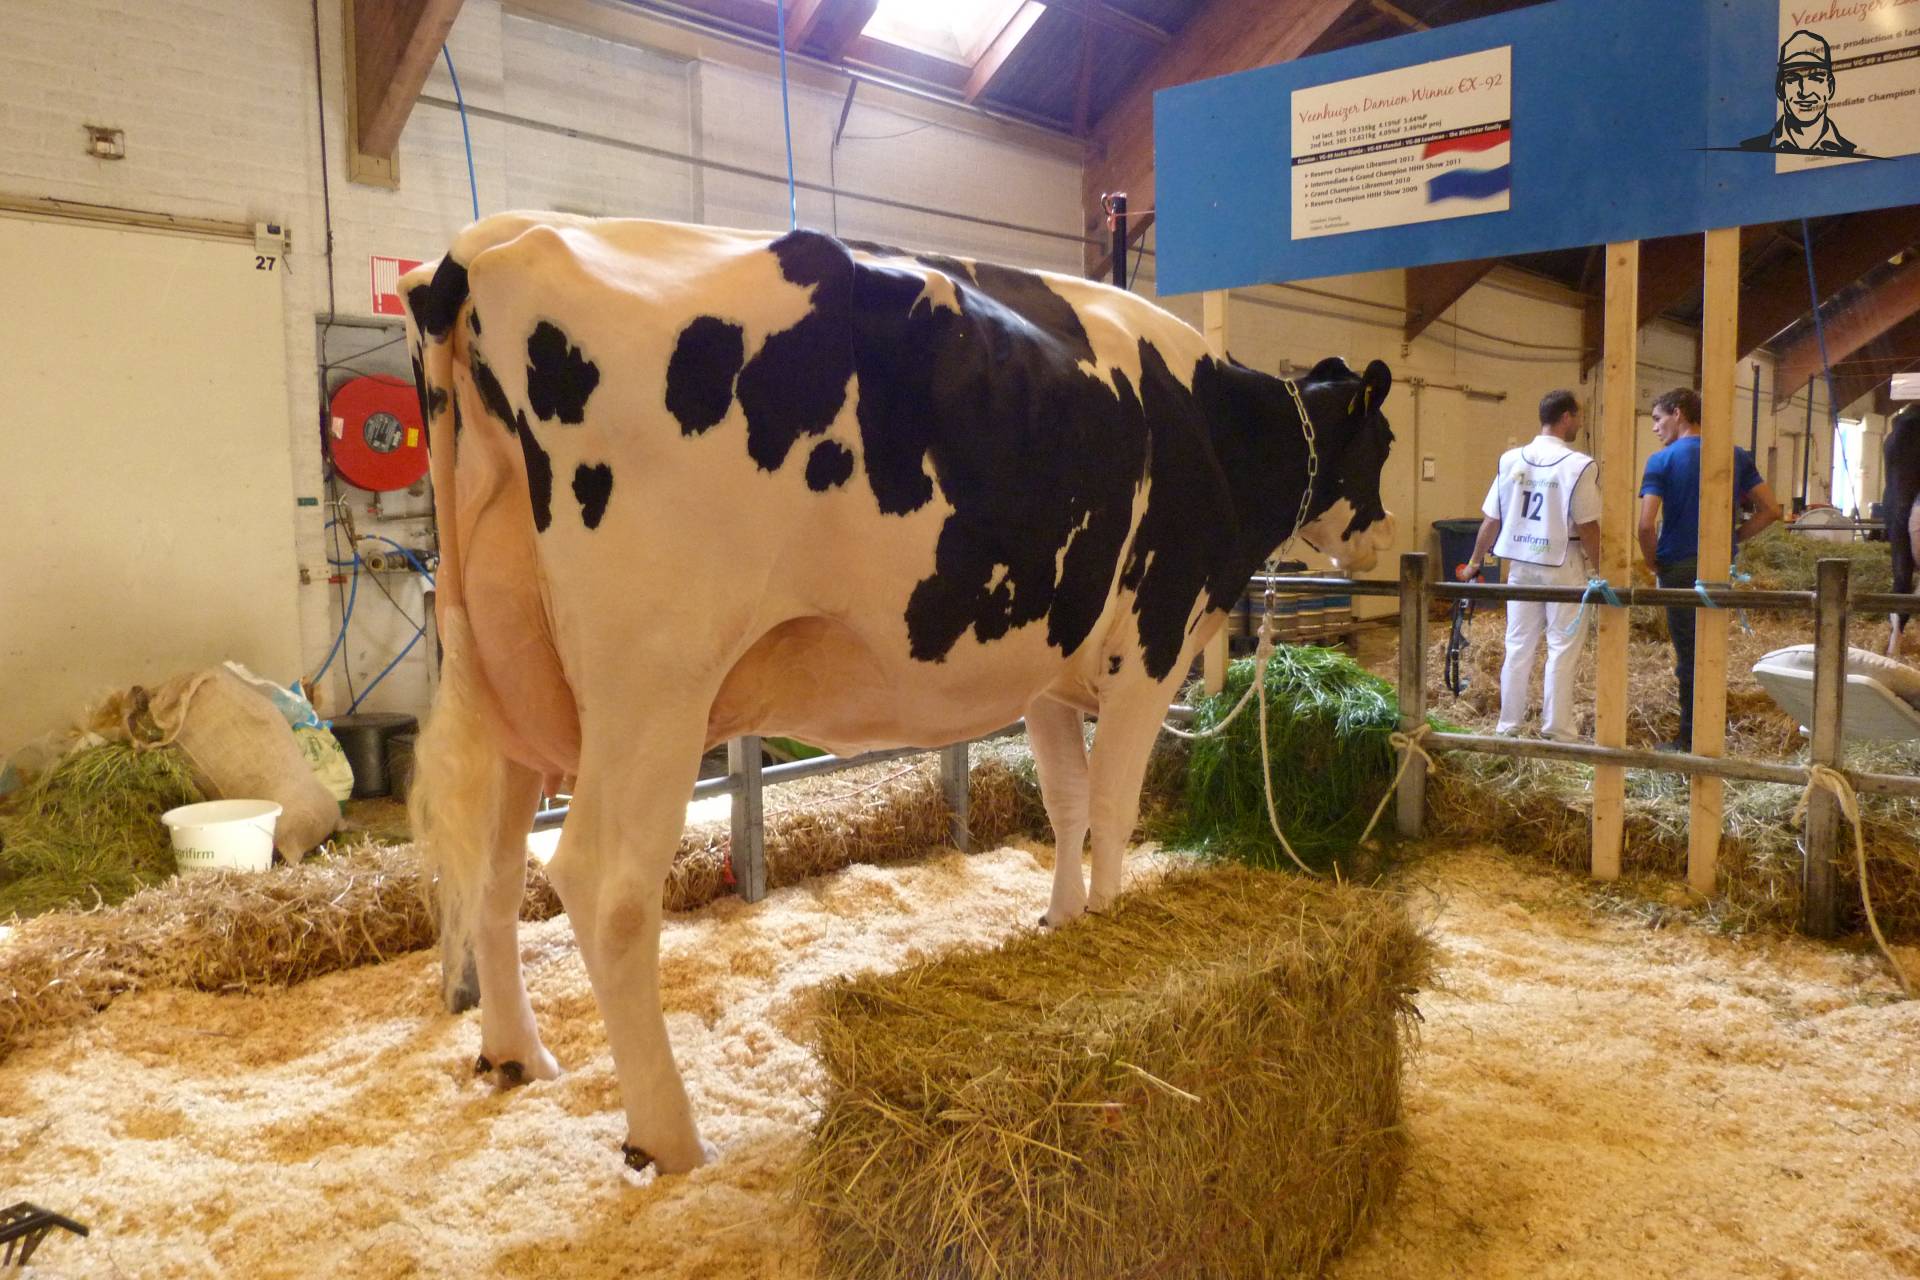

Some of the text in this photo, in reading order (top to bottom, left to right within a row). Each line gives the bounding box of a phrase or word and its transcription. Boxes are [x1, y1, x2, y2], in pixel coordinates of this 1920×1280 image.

[1843, 34, 1893, 50] production
[1363, 95, 1408, 112] Damion
[1411, 86, 1454, 102] Winnie
[1868, 89, 1916, 101] Champion
[1310, 169, 1333, 178] Reserve
[1334, 164, 1364, 174] Champion
[1310, 177, 1348, 188] Intermediate
[1356, 172, 1374, 180] Grand
[1376, 167, 1407, 178] Champion
[1426, 161, 1443, 169] Show
[1446, 158, 1461, 166] 2011
[1310, 189, 1328, 197] Grand
[1330, 185, 1360, 195] Champion
[1362, 180, 1393, 189] Libramont
[1310, 199, 1333, 207] Reserve
[1335, 194, 1365, 204] Champion
[1383, 189, 1400, 197] Show
[255, 255, 276, 271] 27
[1521, 490, 1544, 521] 12
[1513, 534, 1549, 546] uniform
